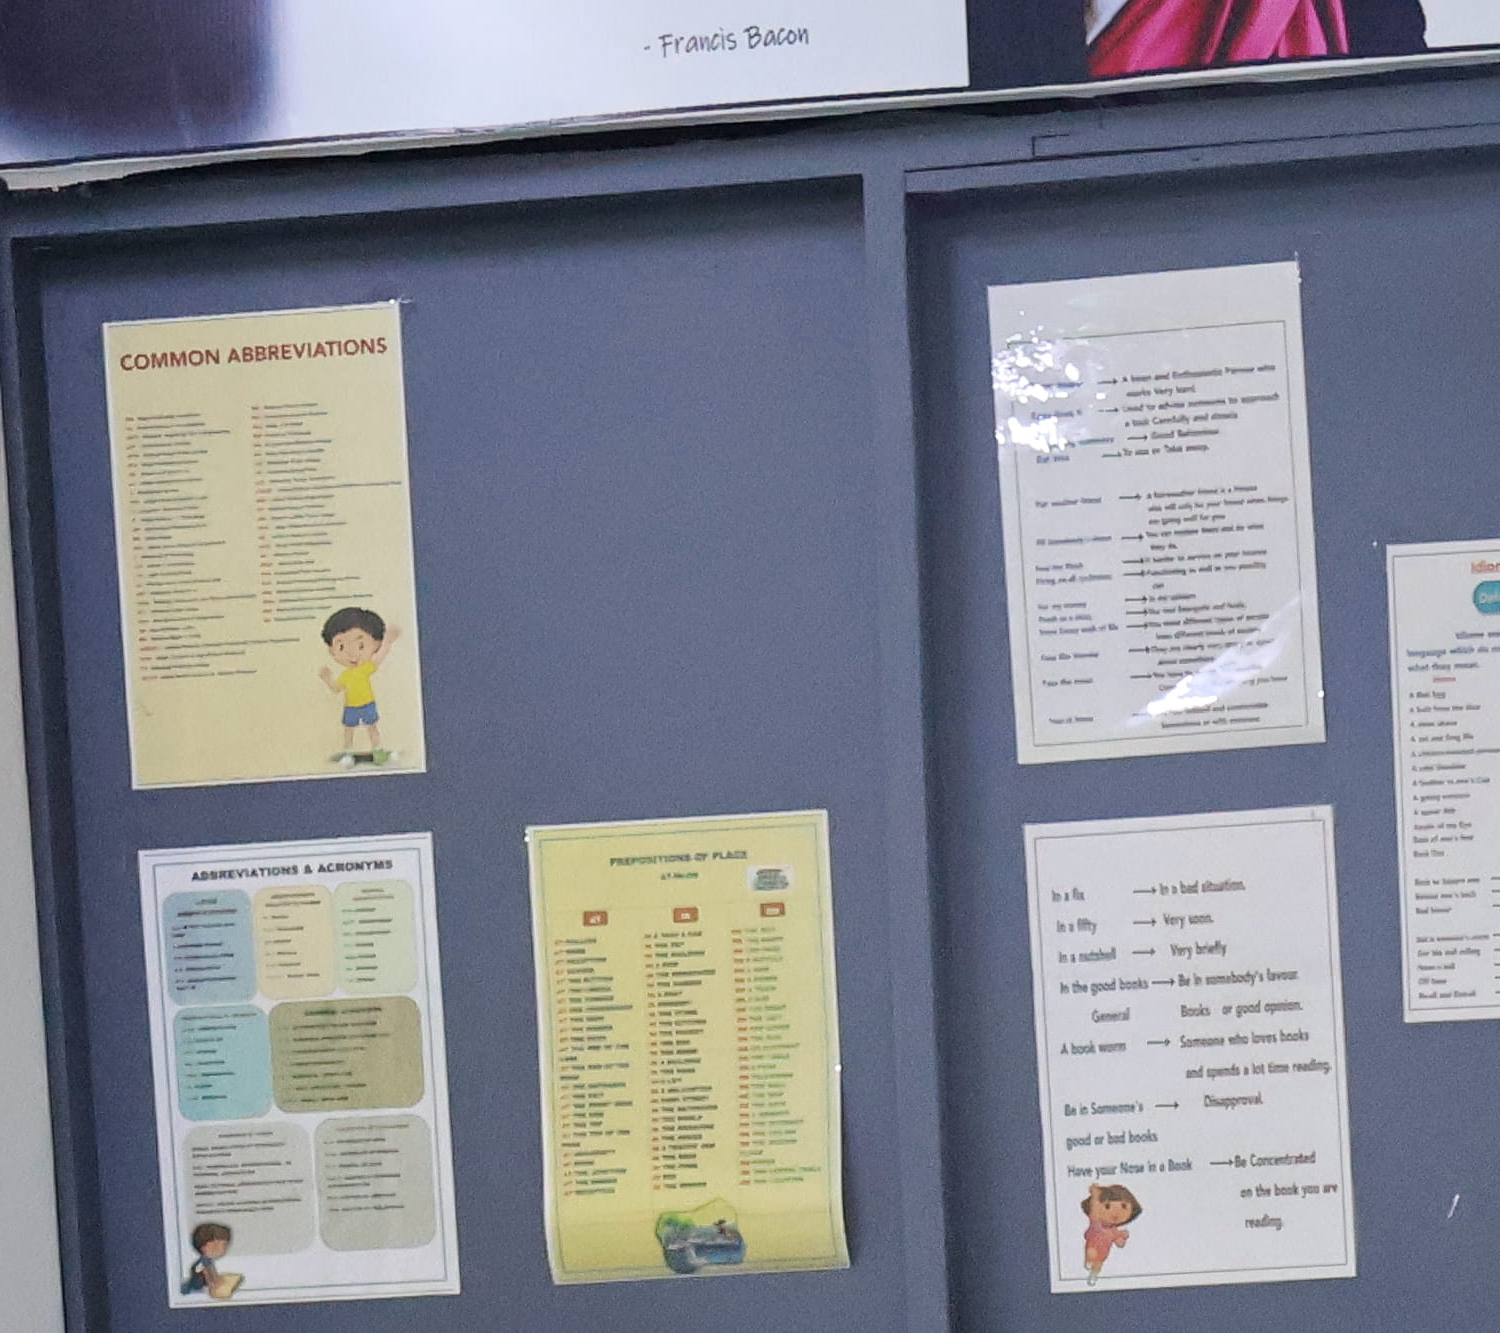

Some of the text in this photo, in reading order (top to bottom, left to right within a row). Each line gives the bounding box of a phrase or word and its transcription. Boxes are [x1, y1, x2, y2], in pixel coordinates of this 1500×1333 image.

[658, 27, 737, 58] Francis
[744, 25, 809, 49] Bacon
[120, 337, 388, 372] COMMON ABBREVIATIONS
[191, 866, 299, 882] ABBREVIATIONS
[318, 860, 394, 872] ACRONYMS
[1072, 981, 1088, 994] the
[1090, 979, 1116, 996] good
[1236, 1000, 1261, 1018] good
